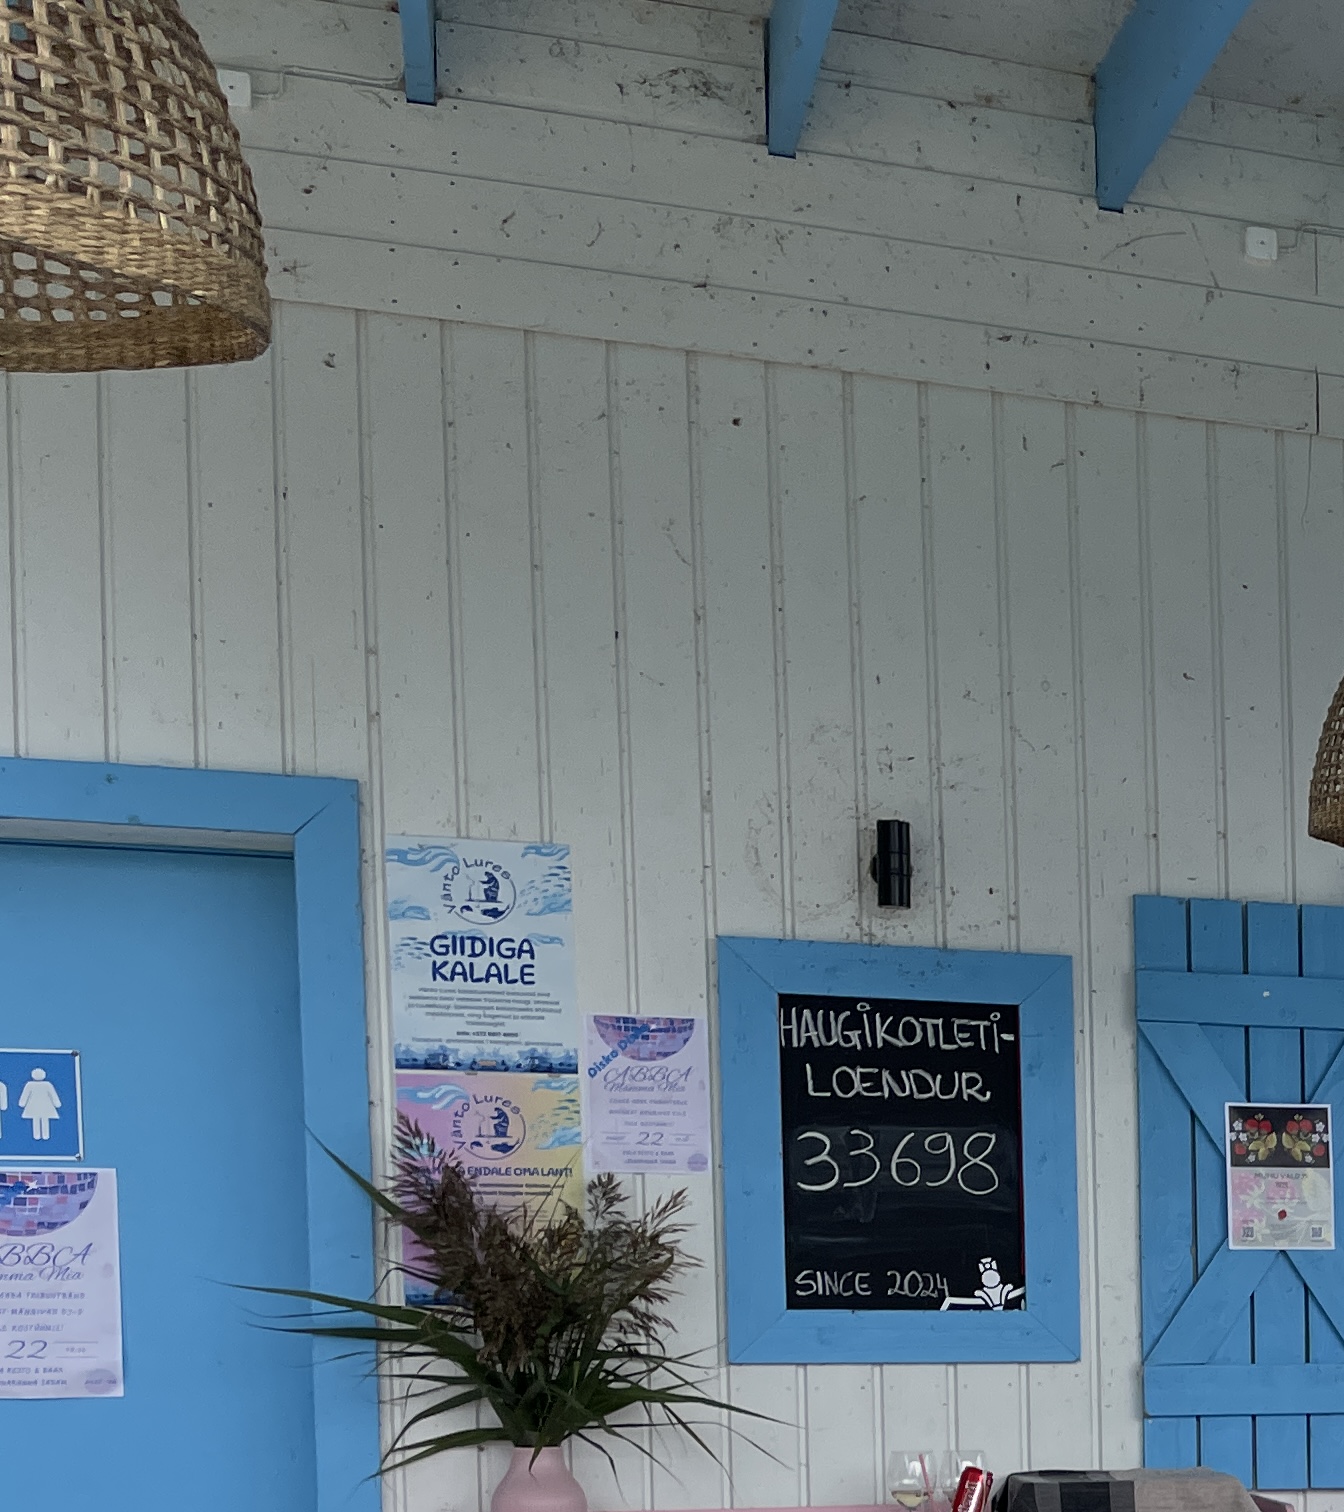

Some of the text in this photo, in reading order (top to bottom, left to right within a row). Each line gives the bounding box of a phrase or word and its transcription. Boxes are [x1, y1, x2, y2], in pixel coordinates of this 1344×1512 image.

[463, 857, 511, 880] Lures
[429, 934, 536, 960] GIIDIGA
[431, 960, 536, 985] KALALE
[588, 1049, 618, 1078] Disko
[806, 1063, 992, 1102] LOENDUR
[472, 1093, 521, 1115] Lures
[635, 1131, 664, 1146] 22
[467, 1166, 514, 1176] ENDALE
[514, 1167, 540, 1176] OMA
[796, 1129, 1000, 1195] 33698
[0, 1242, 94, 1268] BBA
[39, 1266, 82, 1281] Mia
[794, 1269, 949, 1298] SINCE 2024
[4, 1340, 48, 1359] 22
